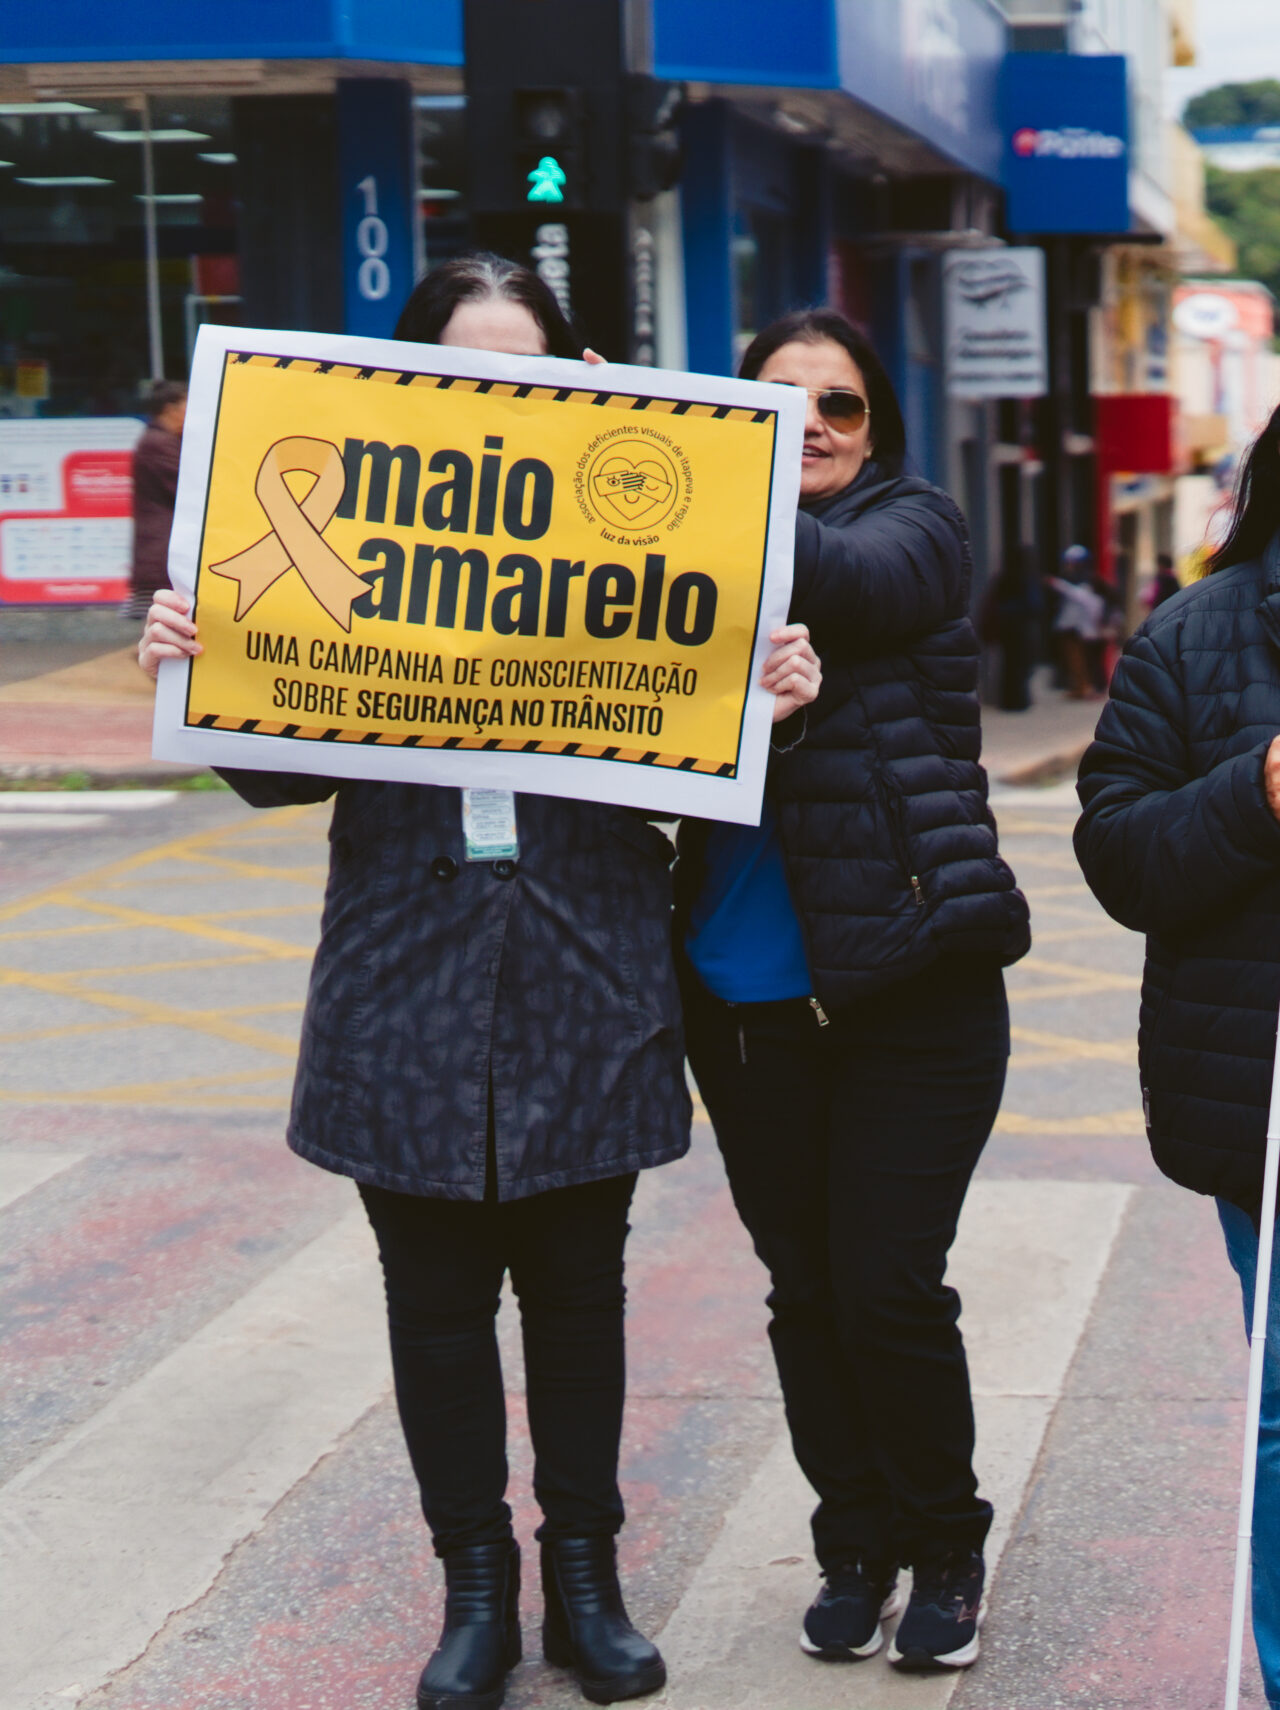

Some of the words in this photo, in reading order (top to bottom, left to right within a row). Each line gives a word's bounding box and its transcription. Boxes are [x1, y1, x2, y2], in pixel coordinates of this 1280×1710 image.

[356, 175, 391, 300] 100
[587, 425, 639, 452] deficientes
[640, 426, 673, 448] visuais
[671, 445, 684, 458] de
[576, 452, 591, 470] dos
[680, 456, 693, 495] itapeva
[336, 435, 554, 541] maio
[573, 470, 596, 524] associação
[684, 495, 692, 503] e
[666, 504, 689, 532] região
[600, 527, 616, 542] luz
[617, 535, 630, 545] da
[632, 534, 660, 546] visão
[351, 537, 718, 647] amarelo
[246, 630, 300, 667] UMA
[309, 639, 444, 684] CAMPANHA
[453, 657, 483, 686] DE
[490, 658, 698, 703] CONSCIENTIZAÇÃO
[272, 677, 349, 717] SOBRE
[356, 689, 504, 734] SEGURANÇA
[510, 699, 545, 727] NO
[550, 694, 664, 736] TRÂNSITO
